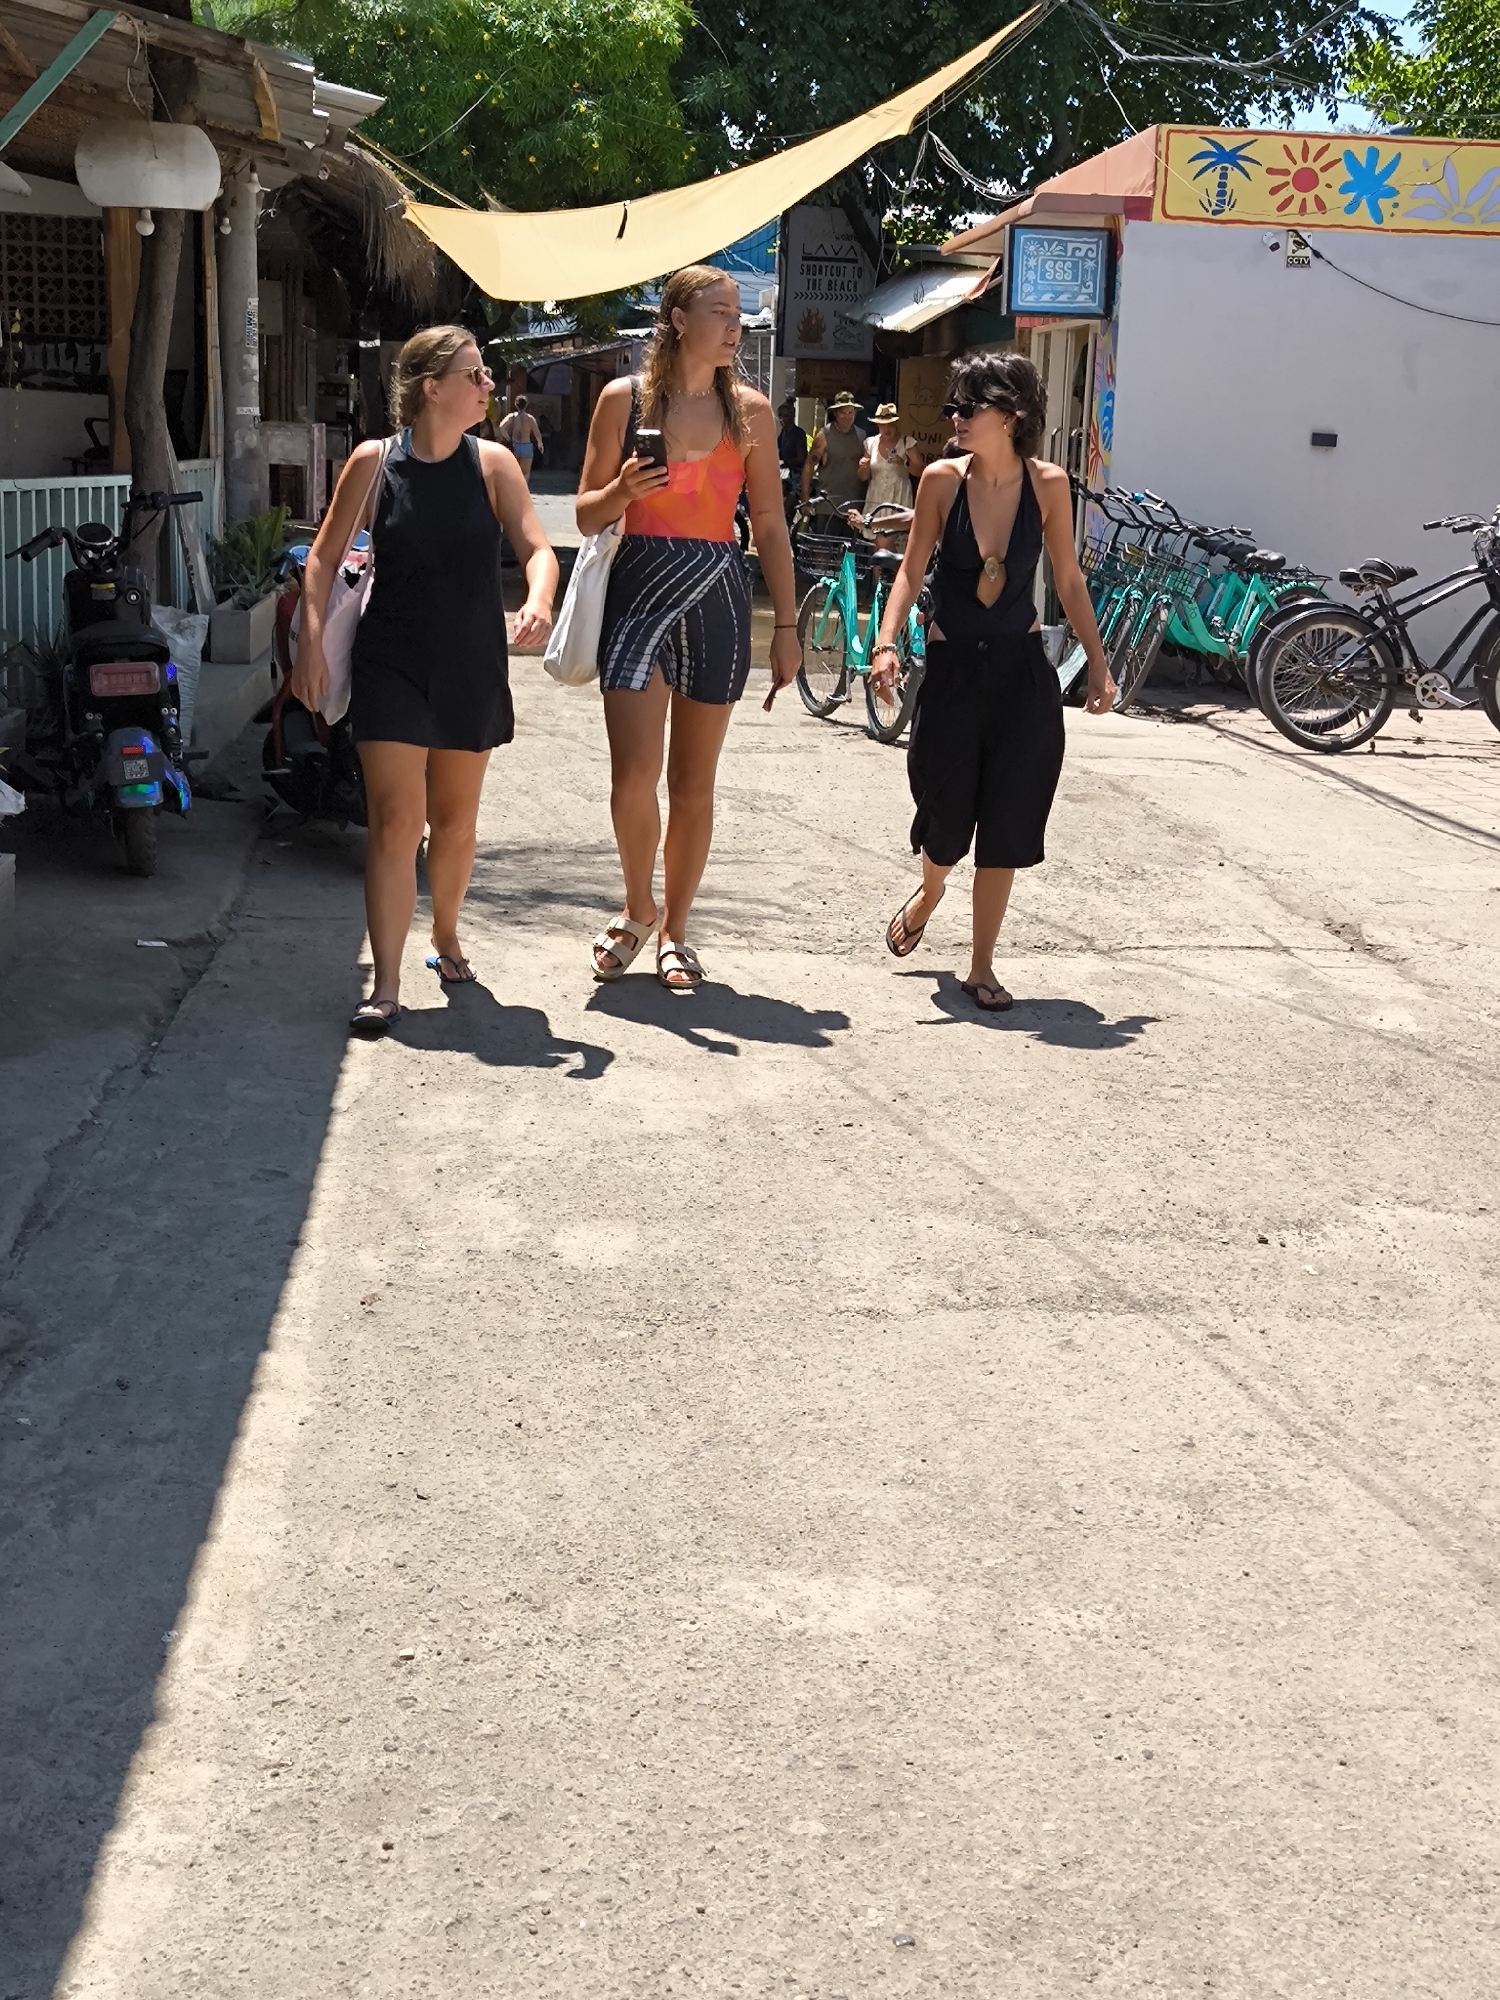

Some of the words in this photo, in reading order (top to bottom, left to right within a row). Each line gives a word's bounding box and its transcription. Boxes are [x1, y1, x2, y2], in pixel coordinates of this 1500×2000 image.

[802, 243, 858, 257] LAVA
[1287, 256, 1310, 264] CCTV
[799, 263, 847, 278] SHORTCUT
[852, 266, 863, 279] TO
[806, 278, 823, 291] THE
[827, 279, 858, 293] BEACH
